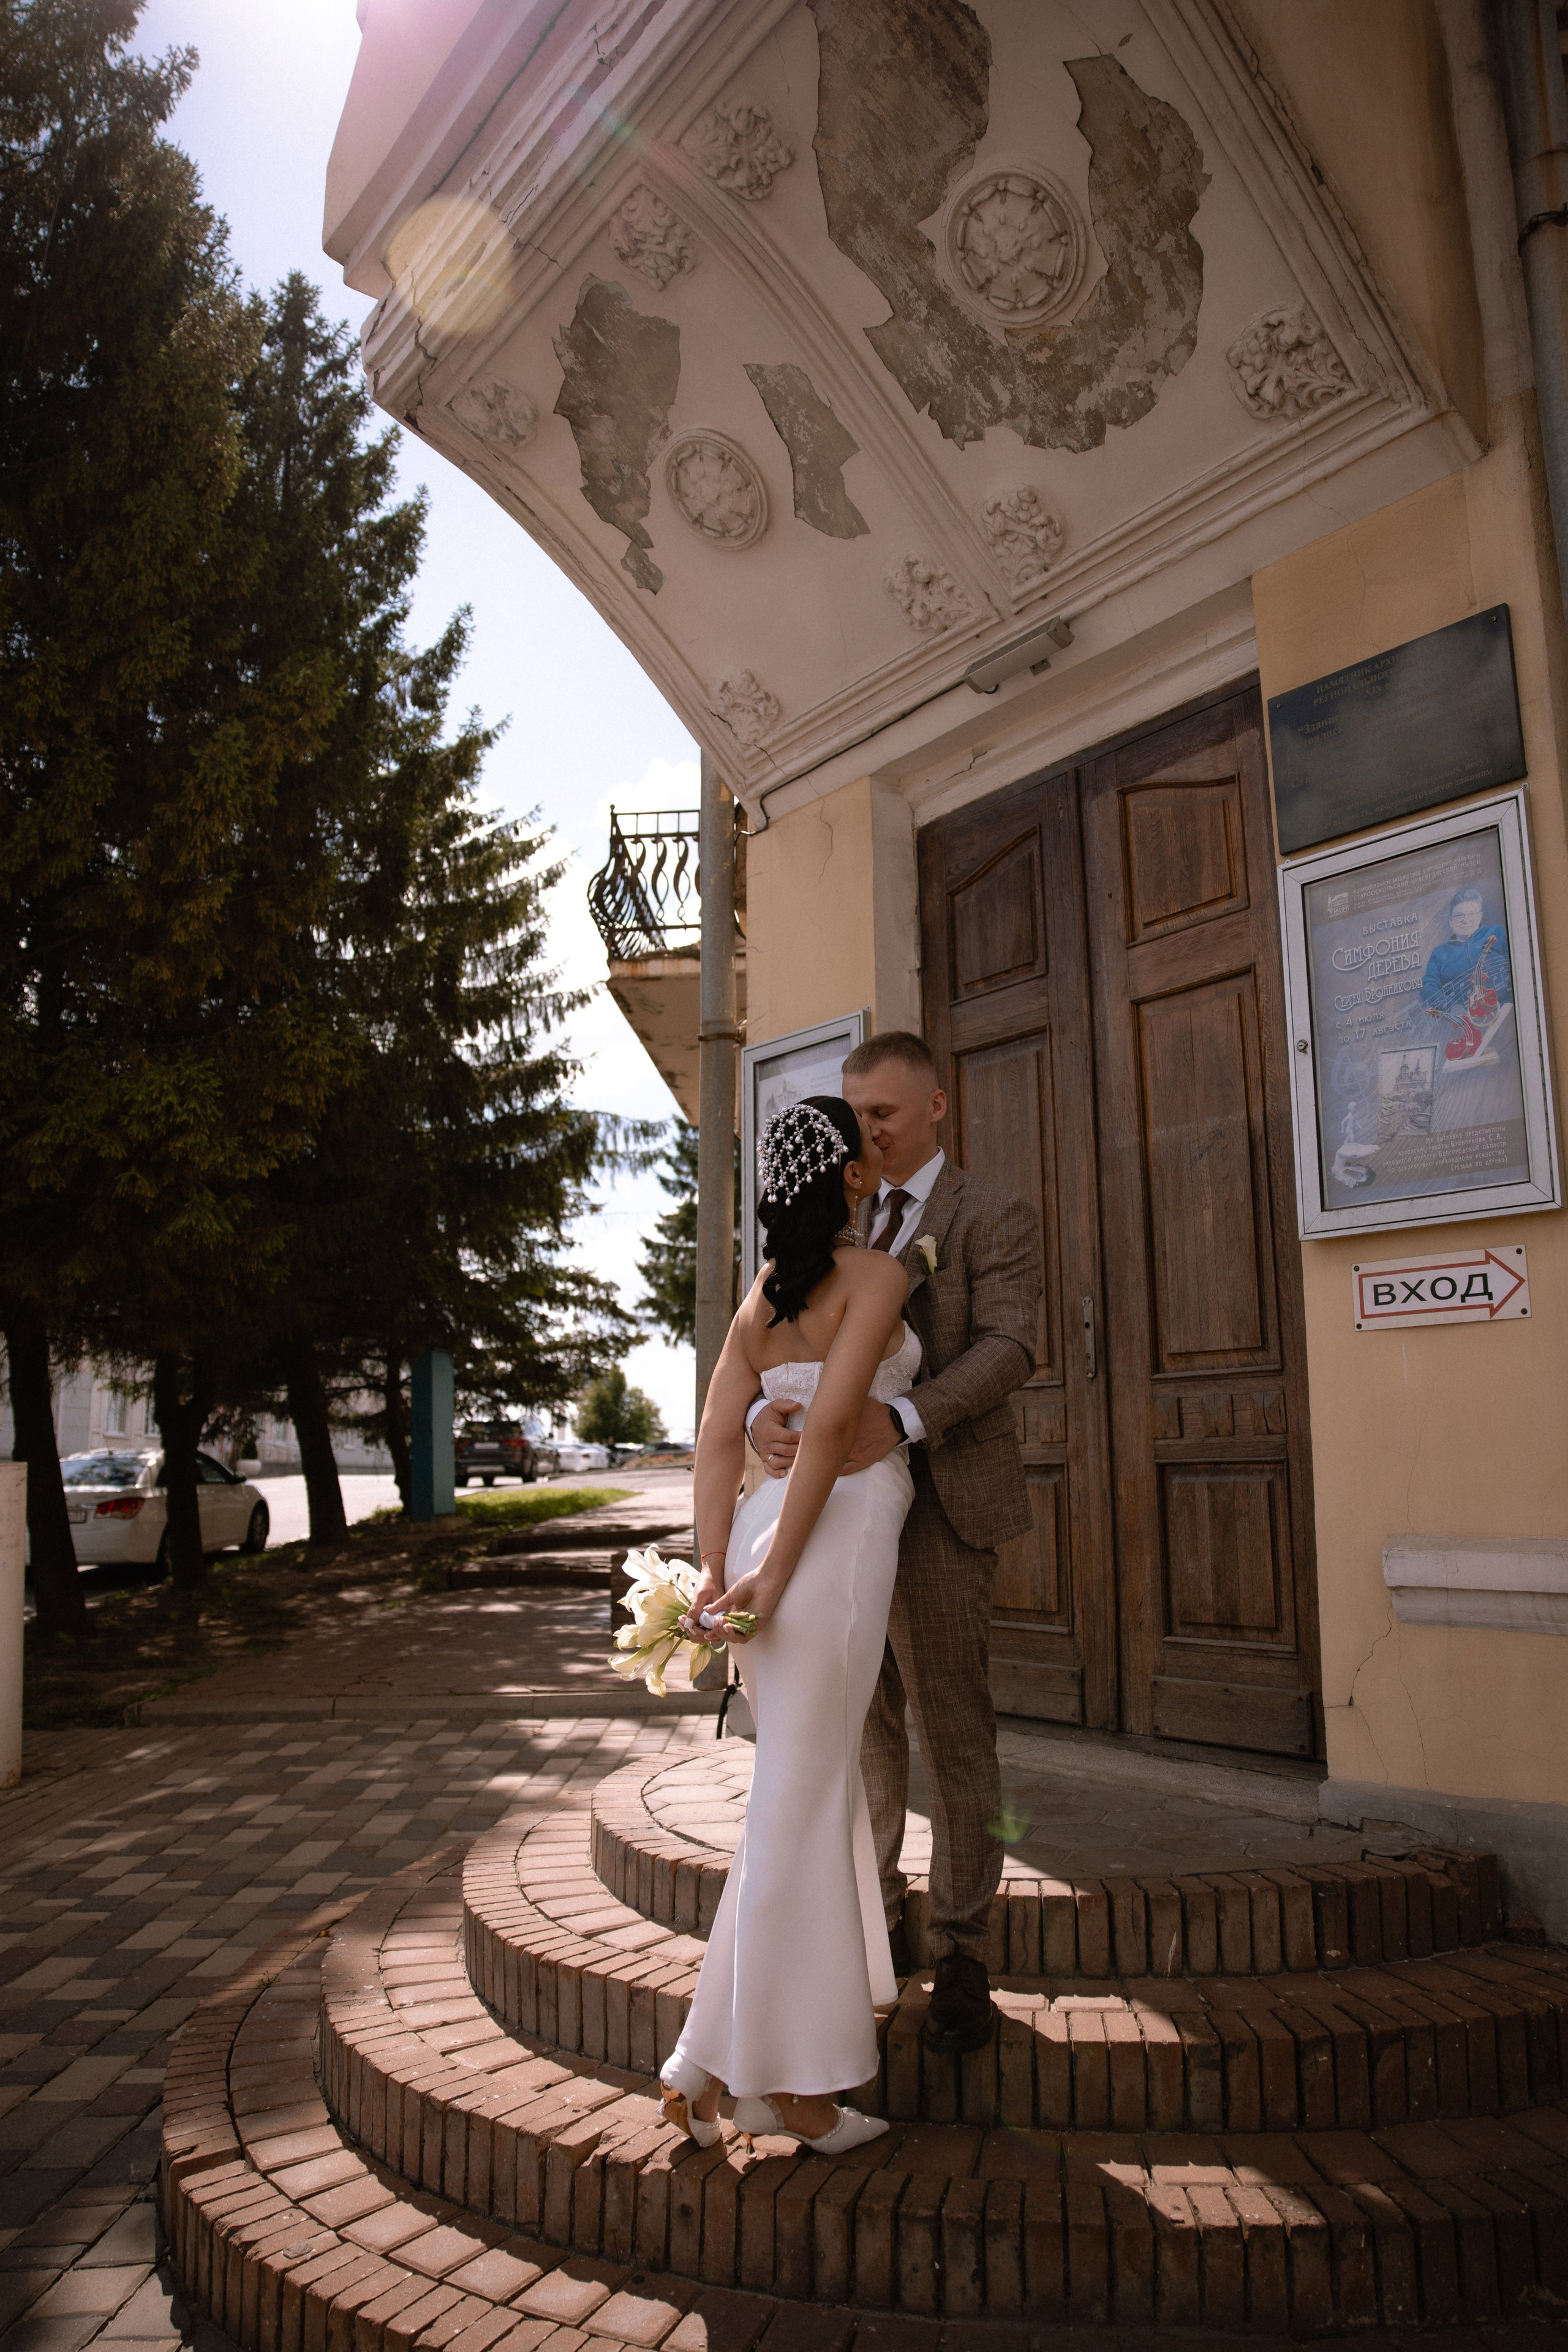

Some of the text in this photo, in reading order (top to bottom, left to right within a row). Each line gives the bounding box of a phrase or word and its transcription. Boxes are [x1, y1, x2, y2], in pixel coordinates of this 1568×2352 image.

[1353, 880, 1409, 900] СТАРООСКОЛЬСКИЙ
[1411, 864, 1458, 884] КРАЕВЕДЧЕСКИЙ
[1460, 858, 1481, 868] МУЗЕЙ
[1363, 913, 1418, 935] ВЫСТАВКА
[1368, 952, 1421, 981] ДЕРЕВА
[1346, 1016, 1352, 1026] 4
[1354, 1028, 1366, 1039] 17
[1465, 1126, 1506, 1137] ПРЕДСТАВЛЕНЫ
[1482, 1141, 1507, 1150] ОБЛАСТИ
[1475, 1149, 1505, 1159] ИСКУССТВУ
[1485, 1155, 1507, 1166] ДЕРЕВУ)
[1373, 1273, 1493, 1306] ВХОД
